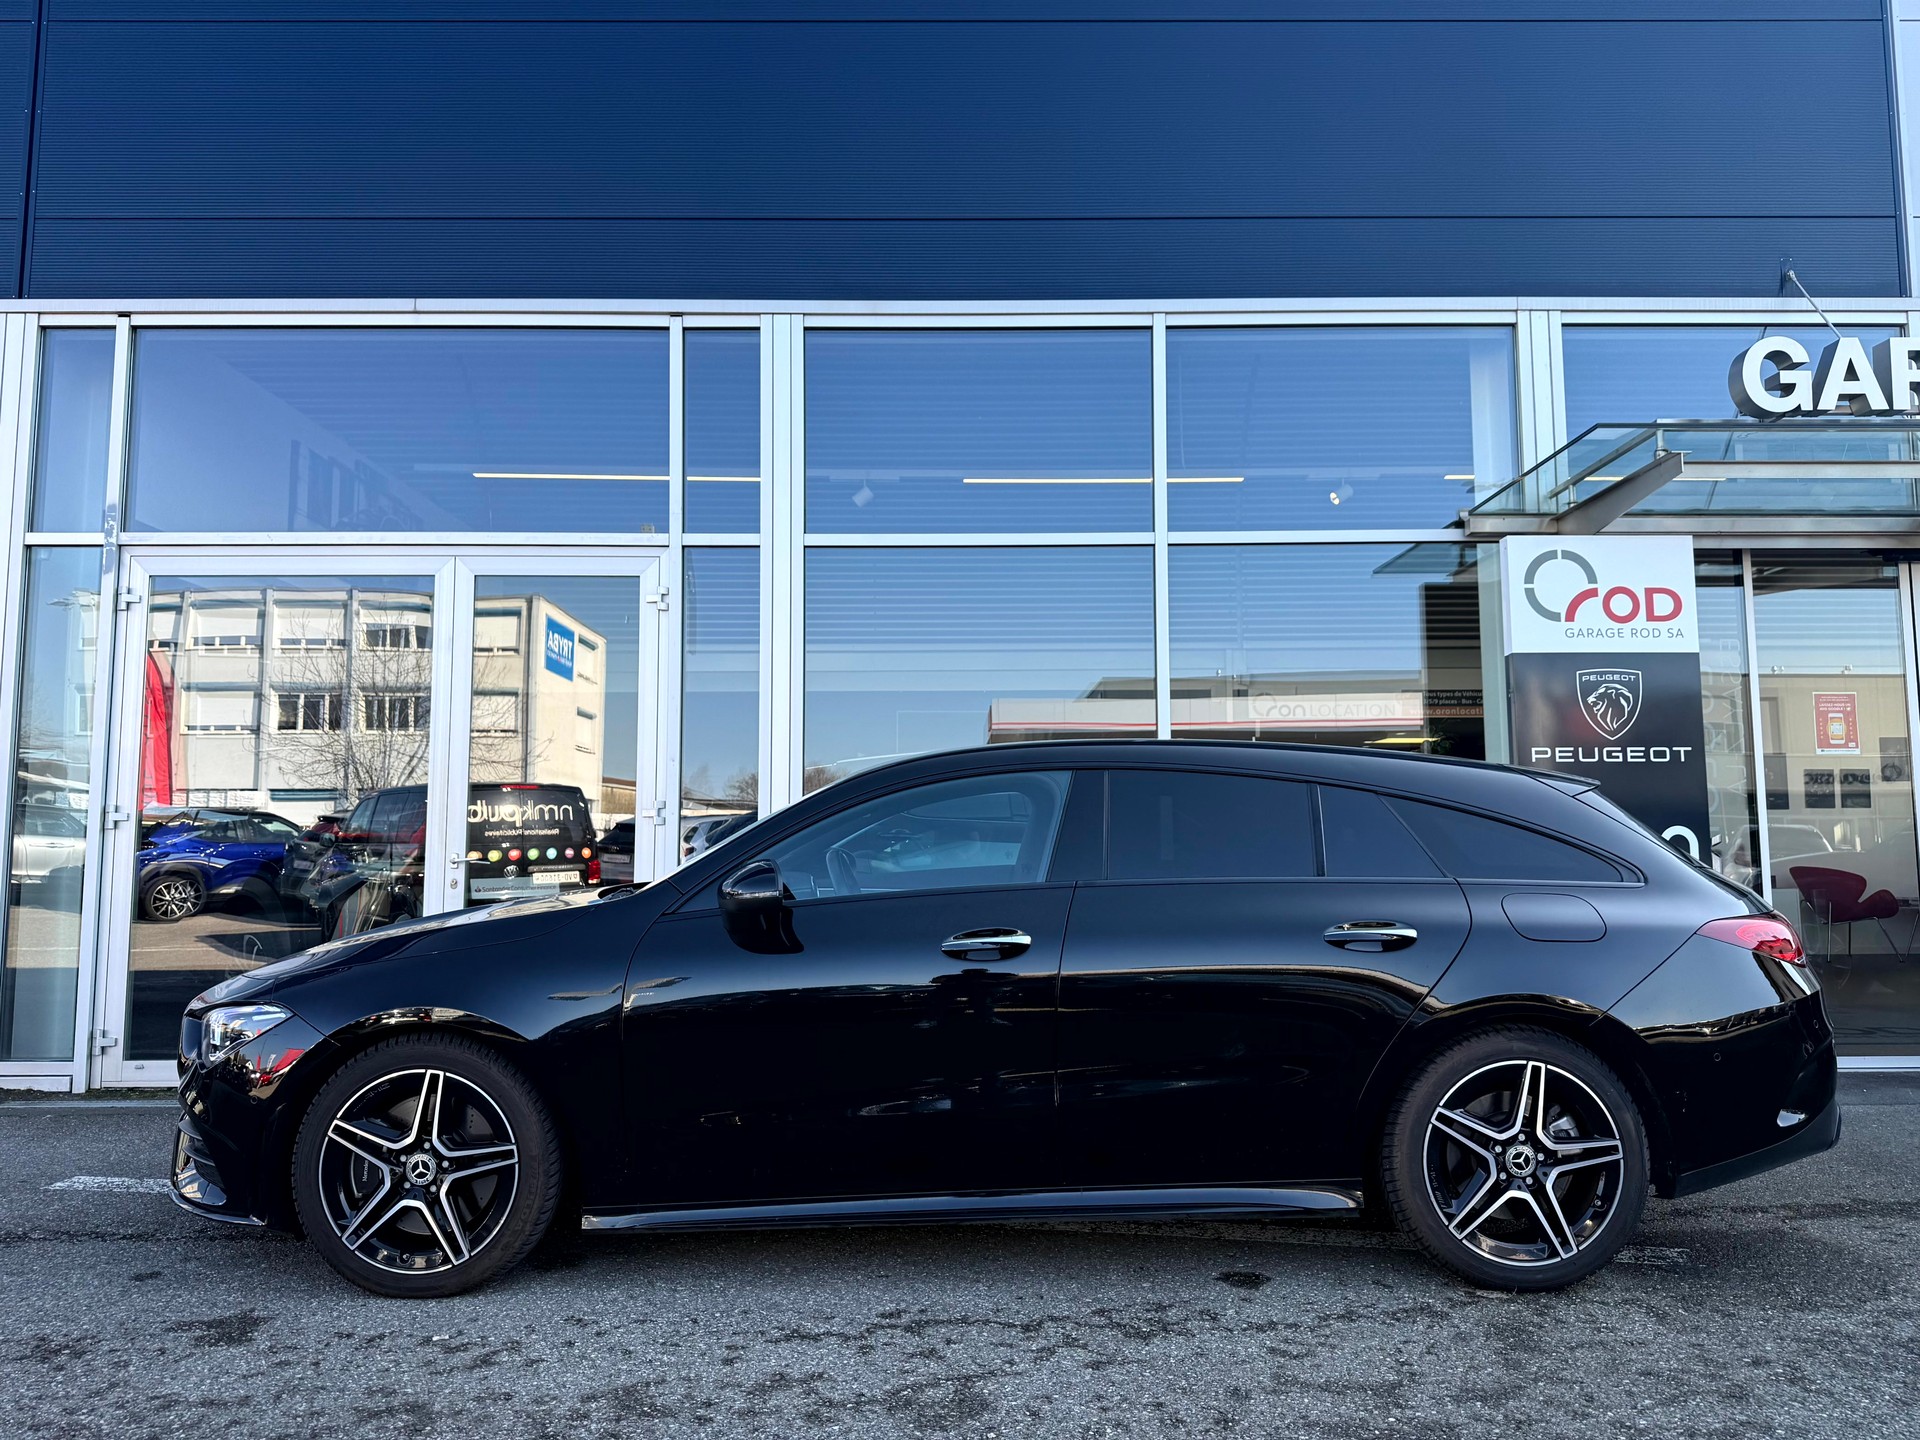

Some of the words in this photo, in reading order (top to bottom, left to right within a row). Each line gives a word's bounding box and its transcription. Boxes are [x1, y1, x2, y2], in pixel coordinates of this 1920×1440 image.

[1564, 627, 1625, 639] GARAGE
[1630, 627, 1662, 639] ROD
[1667, 627, 1684, 639] SA
[1582, 674, 1636, 682] PEUGEOT
[1310, 703, 1396, 718] LOCATION
[1531, 746, 1693, 763] PEUGEOT
